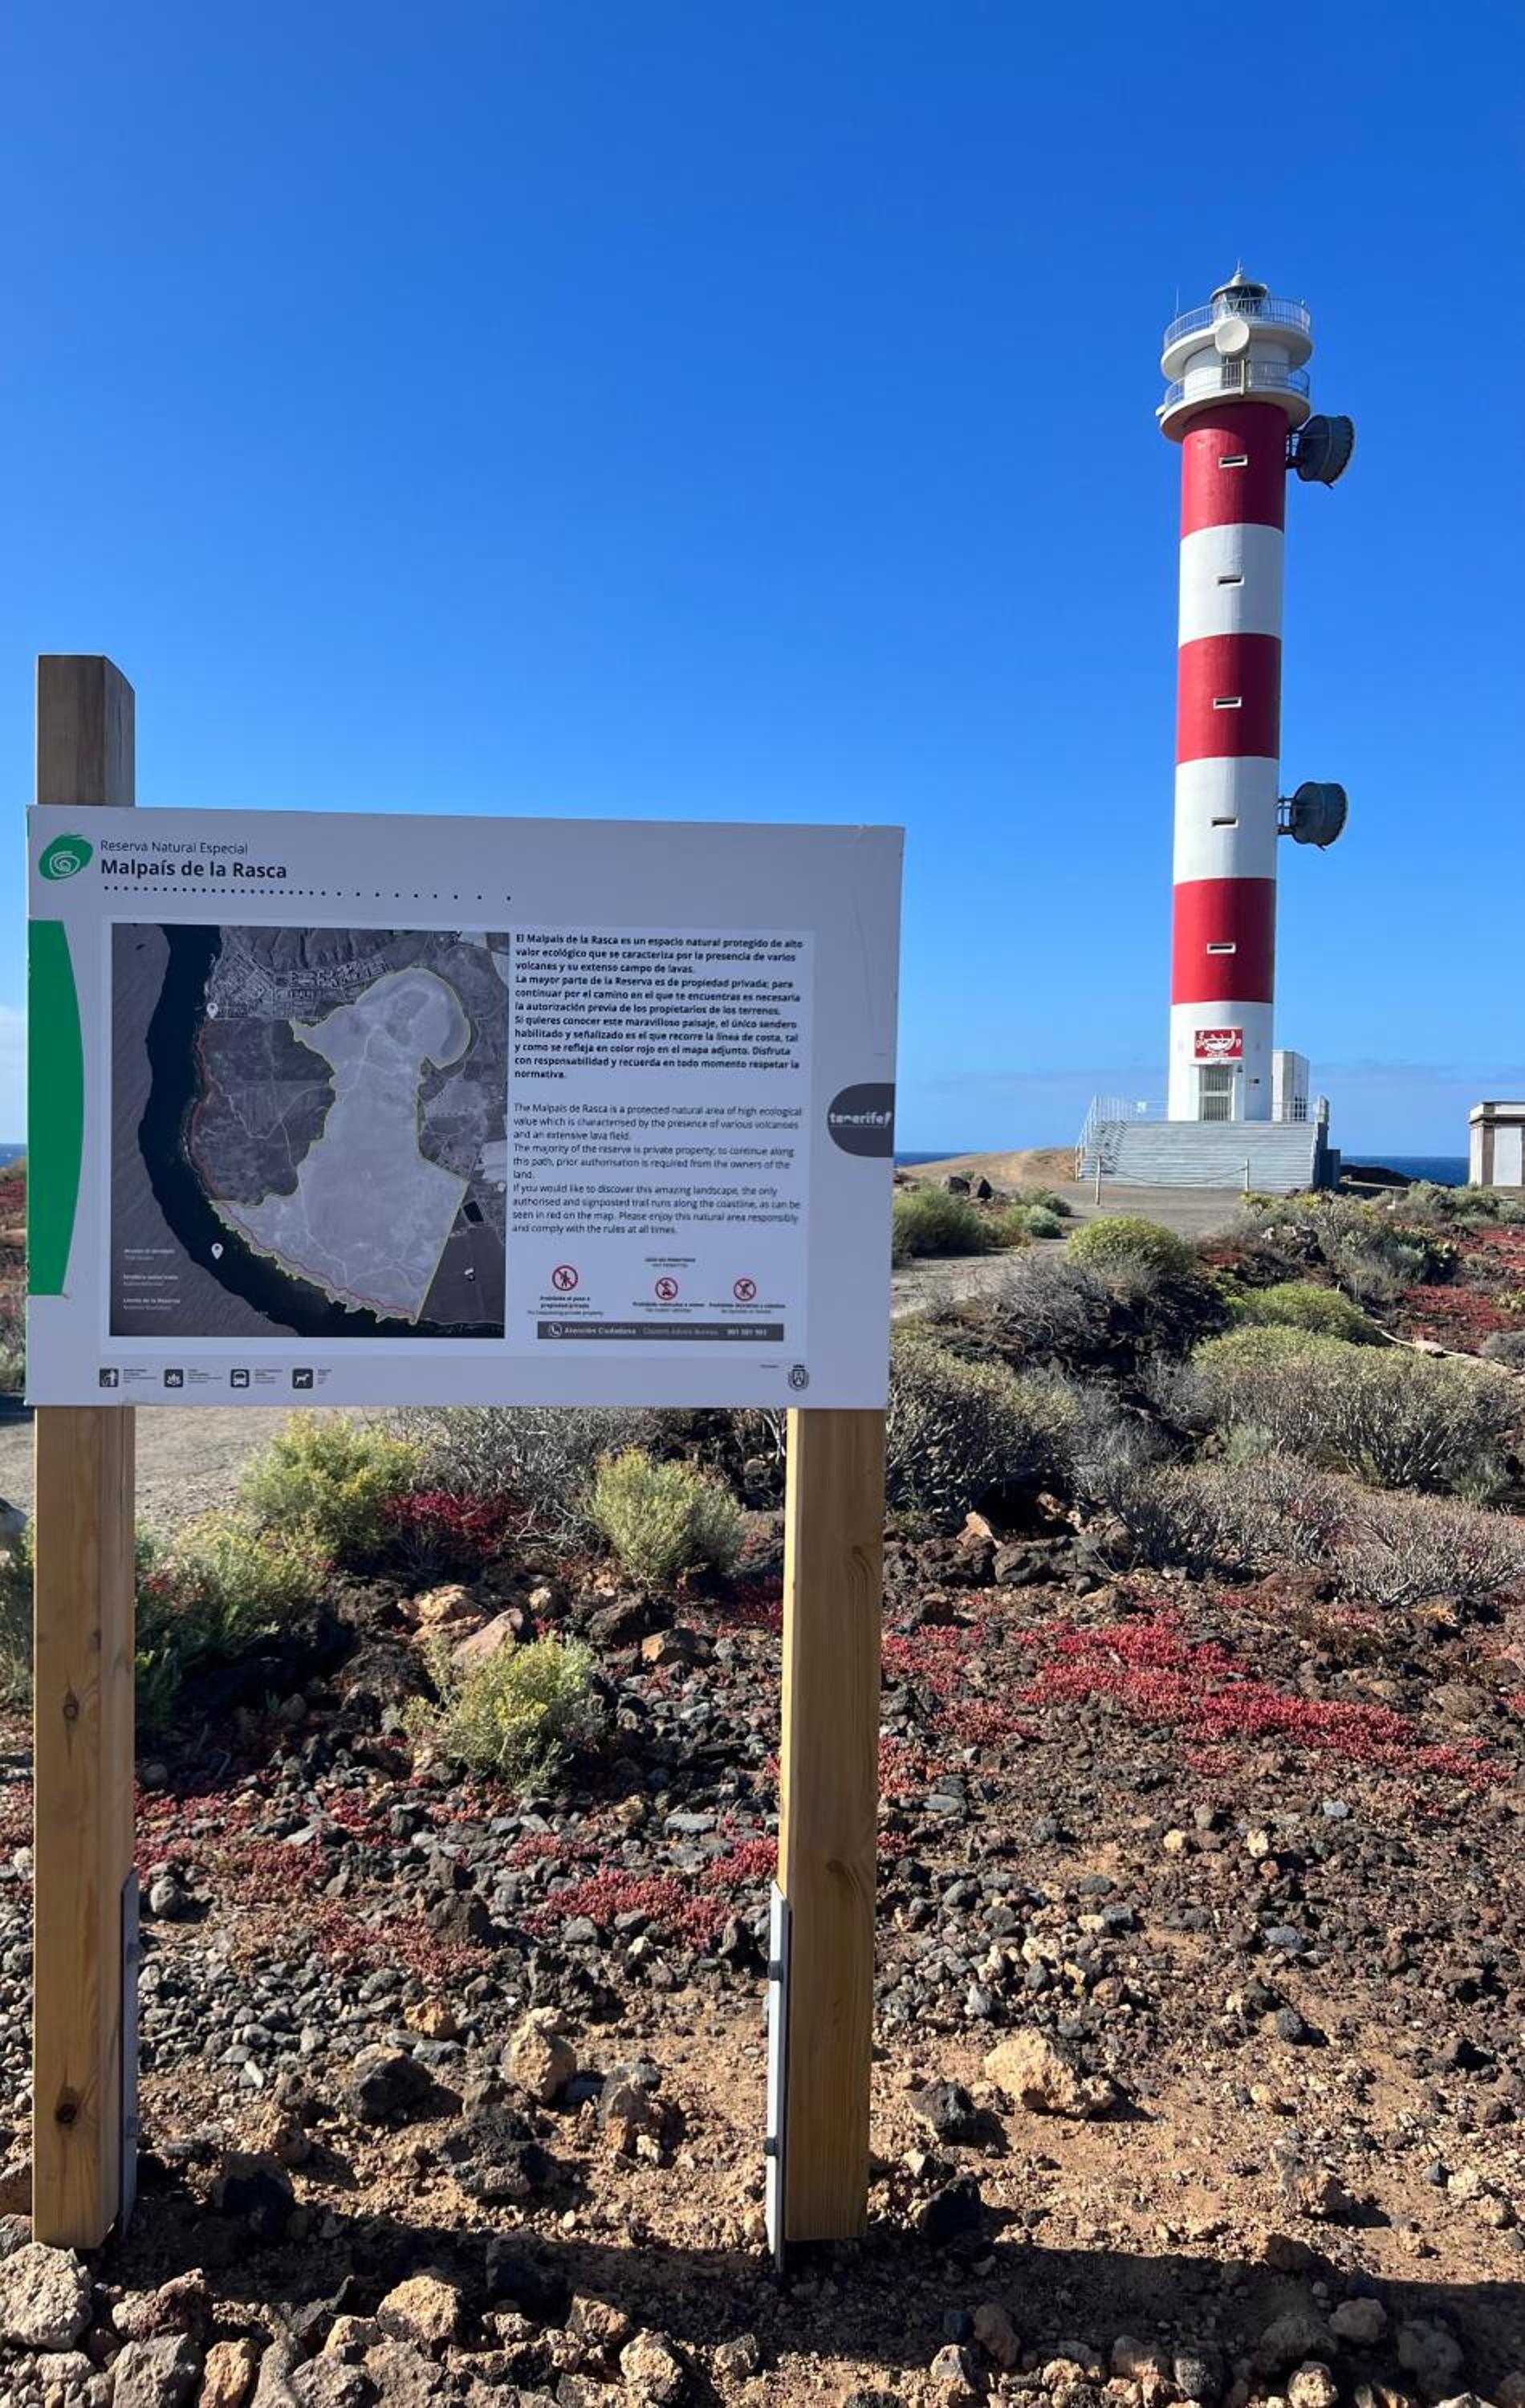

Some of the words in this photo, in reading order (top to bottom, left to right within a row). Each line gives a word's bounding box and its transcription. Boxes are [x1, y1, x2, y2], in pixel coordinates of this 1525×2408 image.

[100, 840, 148, 852] Reserva
[152, 841, 196, 853] Natural
[200, 842, 248, 855] Especial
[100, 859, 175, 878] Malpaís
[181, 860, 205, 876] de
[209, 861, 226, 877] la
[233, 863, 287, 879] Rasca
[515, 934, 524, 942] El
[565, 934, 578, 944] de
[580, 934, 588, 944] la
[591, 935, 619, 945] Rasca
[647, 936, 684, 948] espacio
[685, 937, 721, 946] natural
[722, 938, 768, 950] protegido
[770, 938, 782, 948] de
[784, 939, 803, 948] alto
[515, 947, 540, 957] valor
[588, 950, 608, 960] que
[621, 949, 674, 959] caracteriza
[676, 953, 692, 962] por
[694, 950, 704, 960] la
[706, 950, 750, 963] presencia
[753, 952, 765, 961] de
[767, 952, 795, 962] varios
[515, 961, 558, 970] volcanes
[559, 964, 566, 973] y
[580, 962, 618, 971] extenso
[620, 965, 653, 974] campo
[653, 963, 665, 973] de
[515, 974, 527, 983] La
[528, 977, 560, 986] mayor
[561, 975, 588, 986] parte
[589, 975, 602, 985] de
[604, 976, 612, 985] la
[615, 976, 653, 986] Reserva
[667, 977, 679, 986] de
[681, 978, 730, 990] propiedad
[771, 982, 793, 990] para
[514, 988, 562, 998] continuar
[563, 991, 580, 1000] por
[582, 989, 592, 999] el
[592, 989, 628, 999] camino
[644, 990, 654, 999] el
[655, 993, 673, 1002] que
[675, 990, 685, 1000] te
[687, 991, 741, 1001] encuentras
[514, 1002, 524, 1011] la
[587, 1003, 617, 1015] previa
[619, 1003, 632, 1013] de
[632, 1003, 647, 1013] los
[709, 1005, 721, 1015] de
[722, 1005, 736, 1015] los
[514, 1015, 524, 1024] Si
[525, 1015, 561, 1027] quieres
[562, 1018, 600, 1026] conocer
[602, 1016, 623, 1026] este
[624, 1016, 680, 1027] maravilloso
[720, 1018, 730, 1028] el
[758, 1019, 797, 1029] sendero
[514, 1028, 563, 1038] habilitado
[564, 1031, 571, 1040] y
[637, 1030, 647, 1039] el
[649, 1033, 667, 1042] que
[705, 1031, 714, 1040] la
[741, 1032, 753, 1041] de
[785, 1033, 799, 1042] tal
[514, 1044, 521, 1053] y
[563, 1043, 594, 1054] refleja
[609, 1043, 634, 1053] color
[636, 1043, 655, 1056] rojo
[671, 1044, 680, 1054] el
[681, 1047, 709, 1056] mapa
[751, 1046, 791, 1056] Disfruta
[534, 1055, 609, 1068] responsabilidad
[611, 1059, 616, 1068] y
[618, 1056, 661, 1067] recuerda
[677, 1057, 699, 1068] todo
[701, 1058, 746, 1068] momento
[748, 1059, 788, 1071] respetar
[790, 1060, 799, 1069] la
